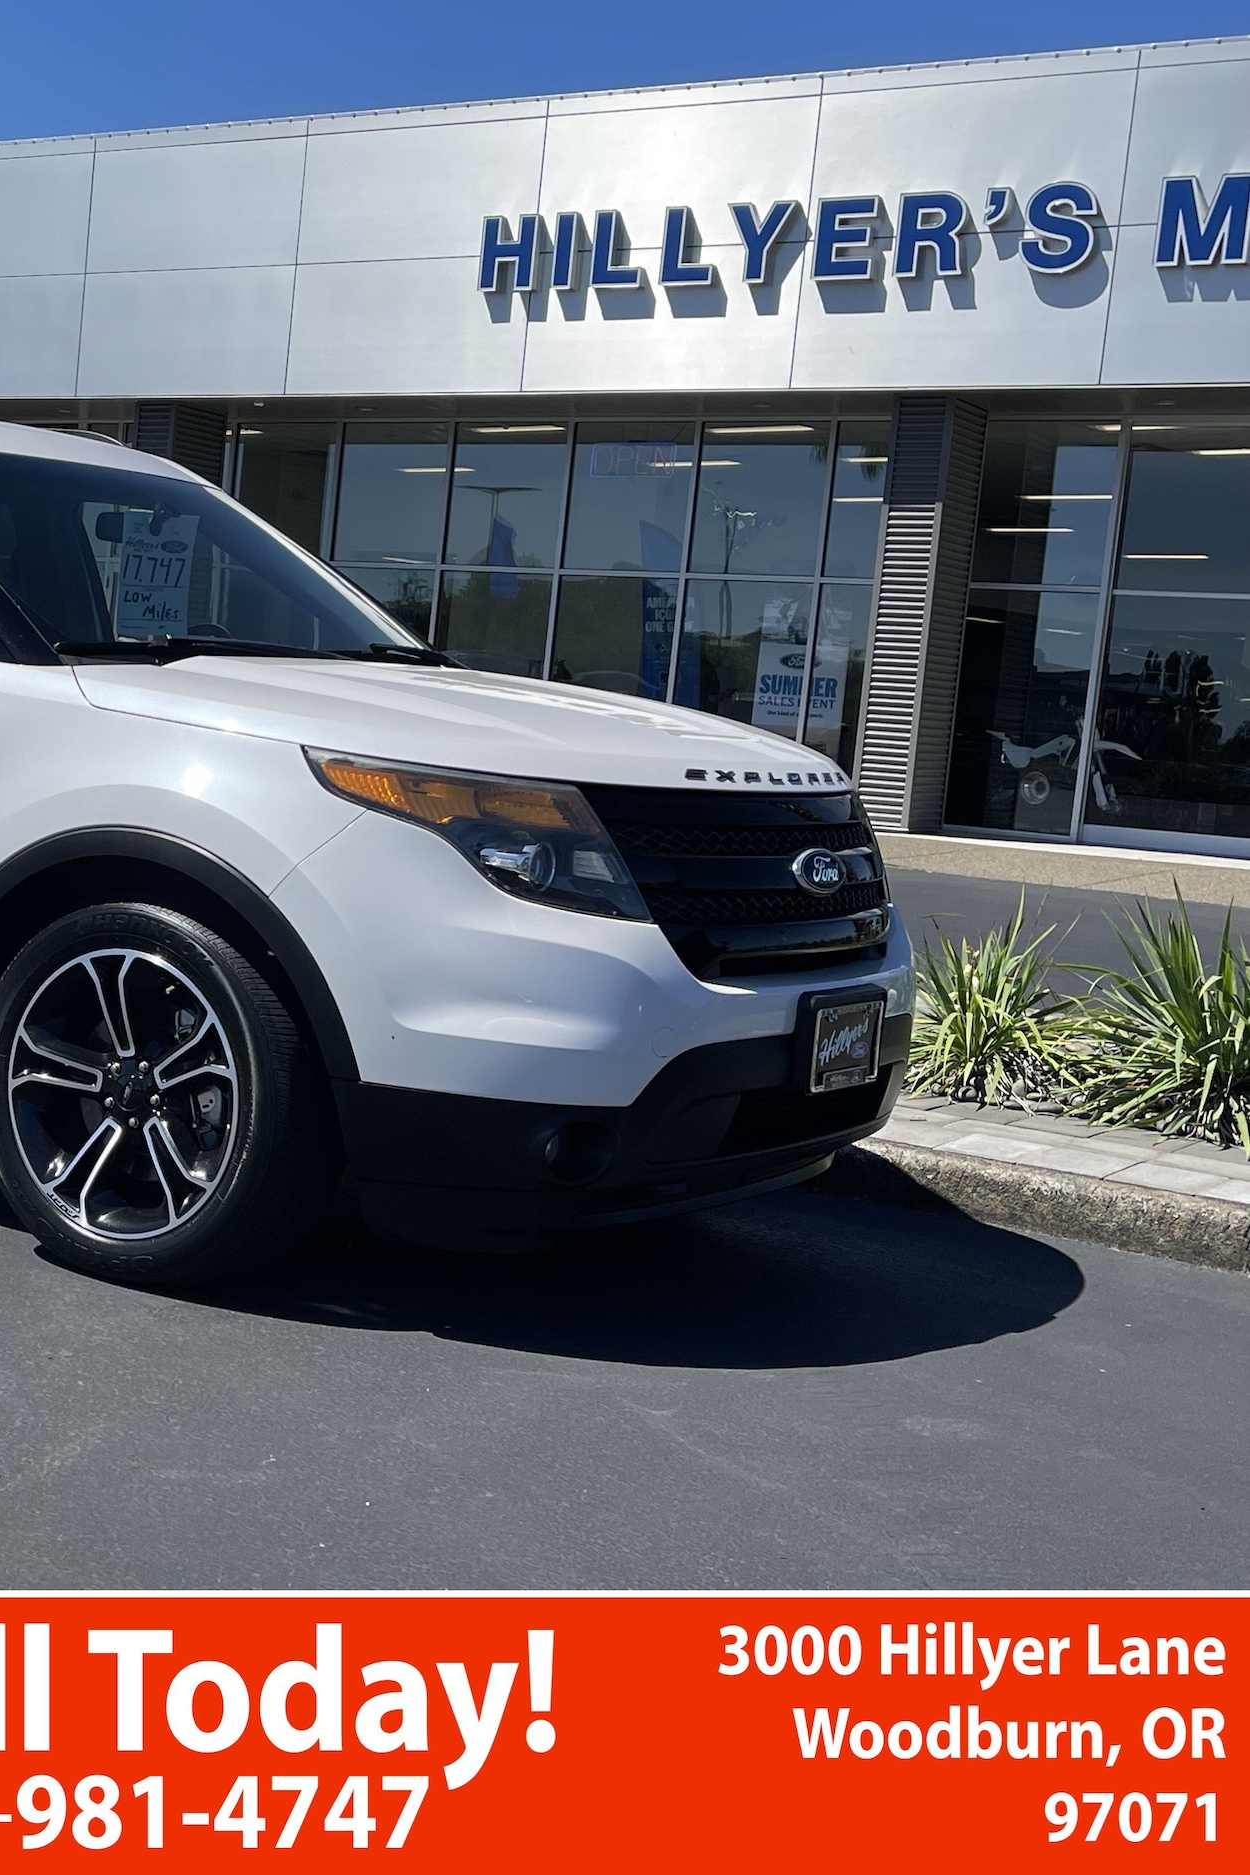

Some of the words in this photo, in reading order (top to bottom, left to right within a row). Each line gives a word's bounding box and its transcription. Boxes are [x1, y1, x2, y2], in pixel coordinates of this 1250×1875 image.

[478, 181, 1103, 292] HILLYER'S
[593, 445, 675, 476] OPEN
[758, 695, 795, 708] SALES
[813, 856, 839, 883] Ford
